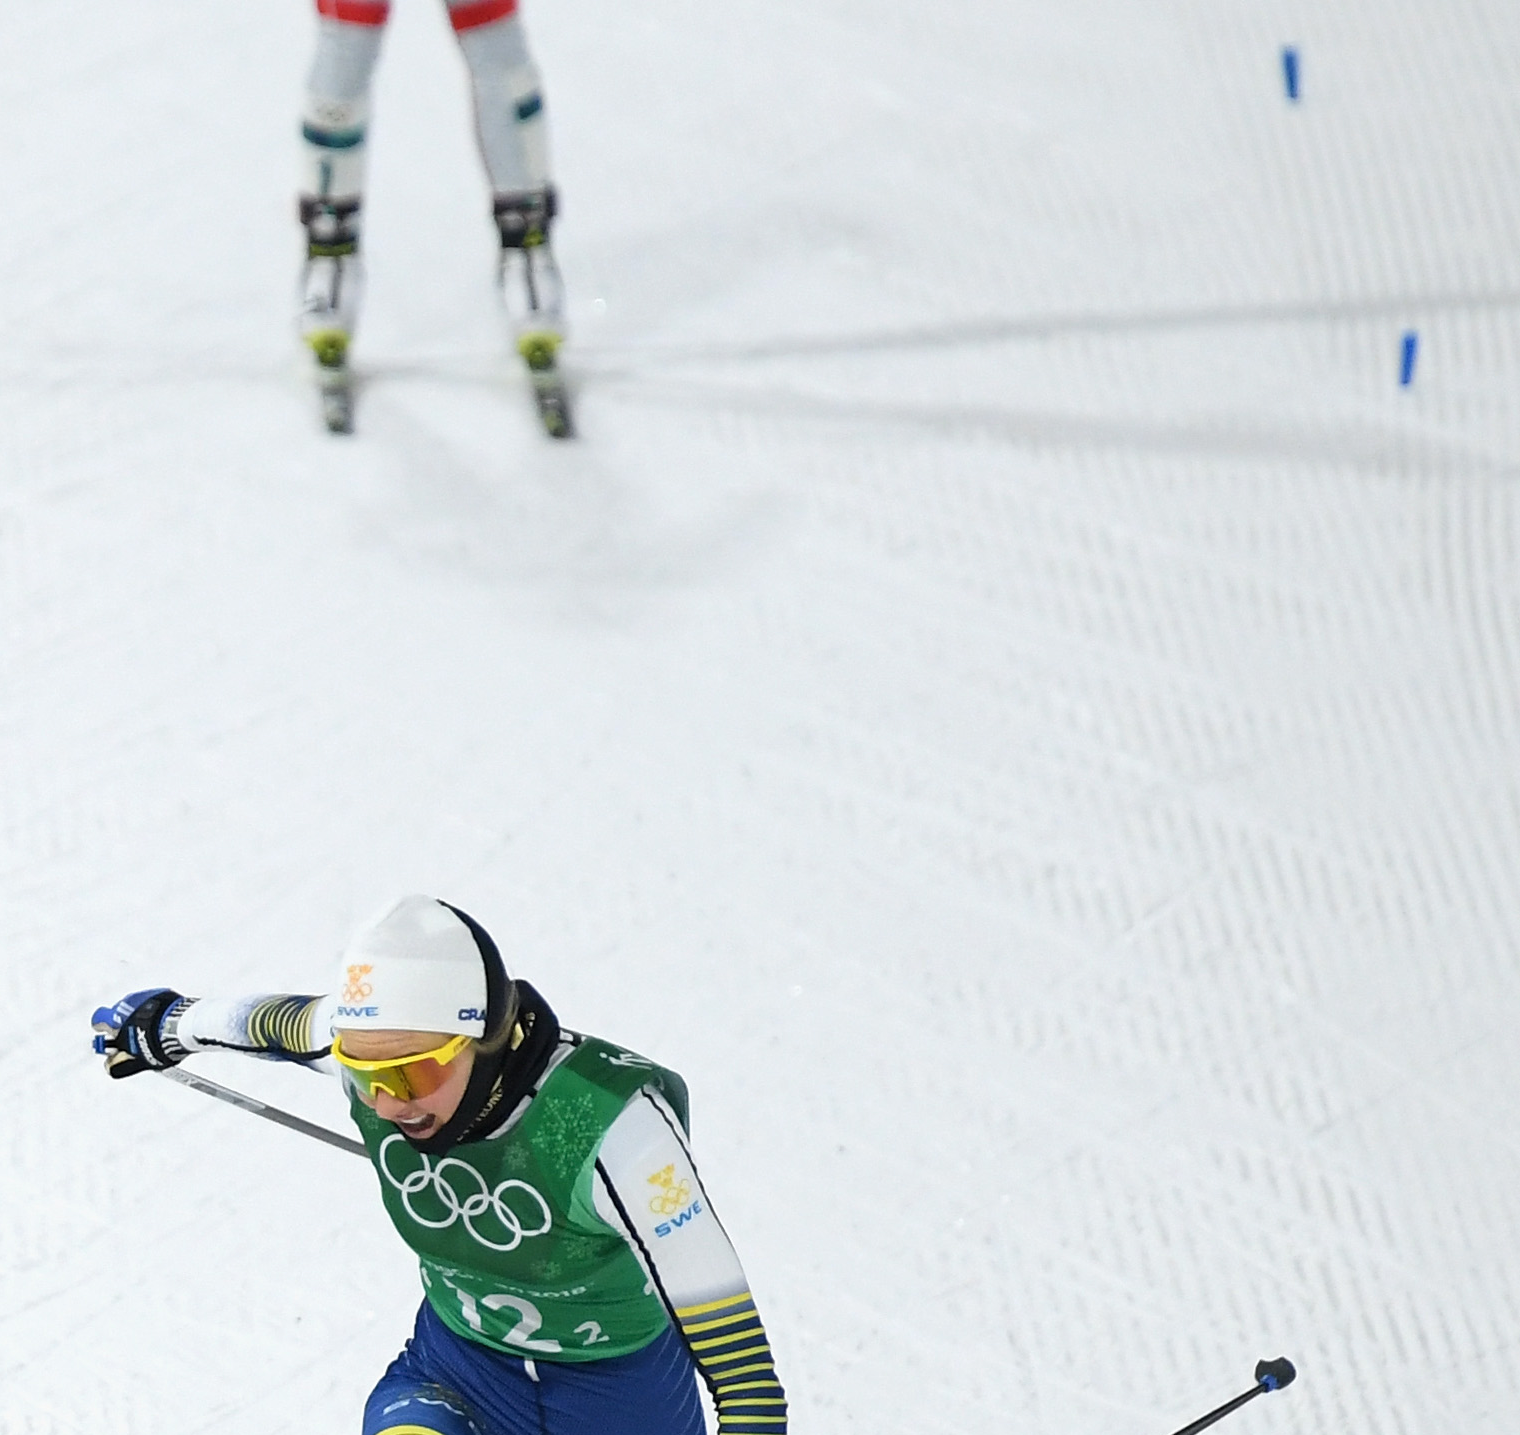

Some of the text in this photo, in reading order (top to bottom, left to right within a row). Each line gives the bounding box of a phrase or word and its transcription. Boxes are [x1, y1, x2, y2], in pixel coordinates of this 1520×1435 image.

[458, 1008, 488, 1021] CRA
[654, 1200, 702, 1238] SWE
[443, 1276, 611, 1354] 12 2
